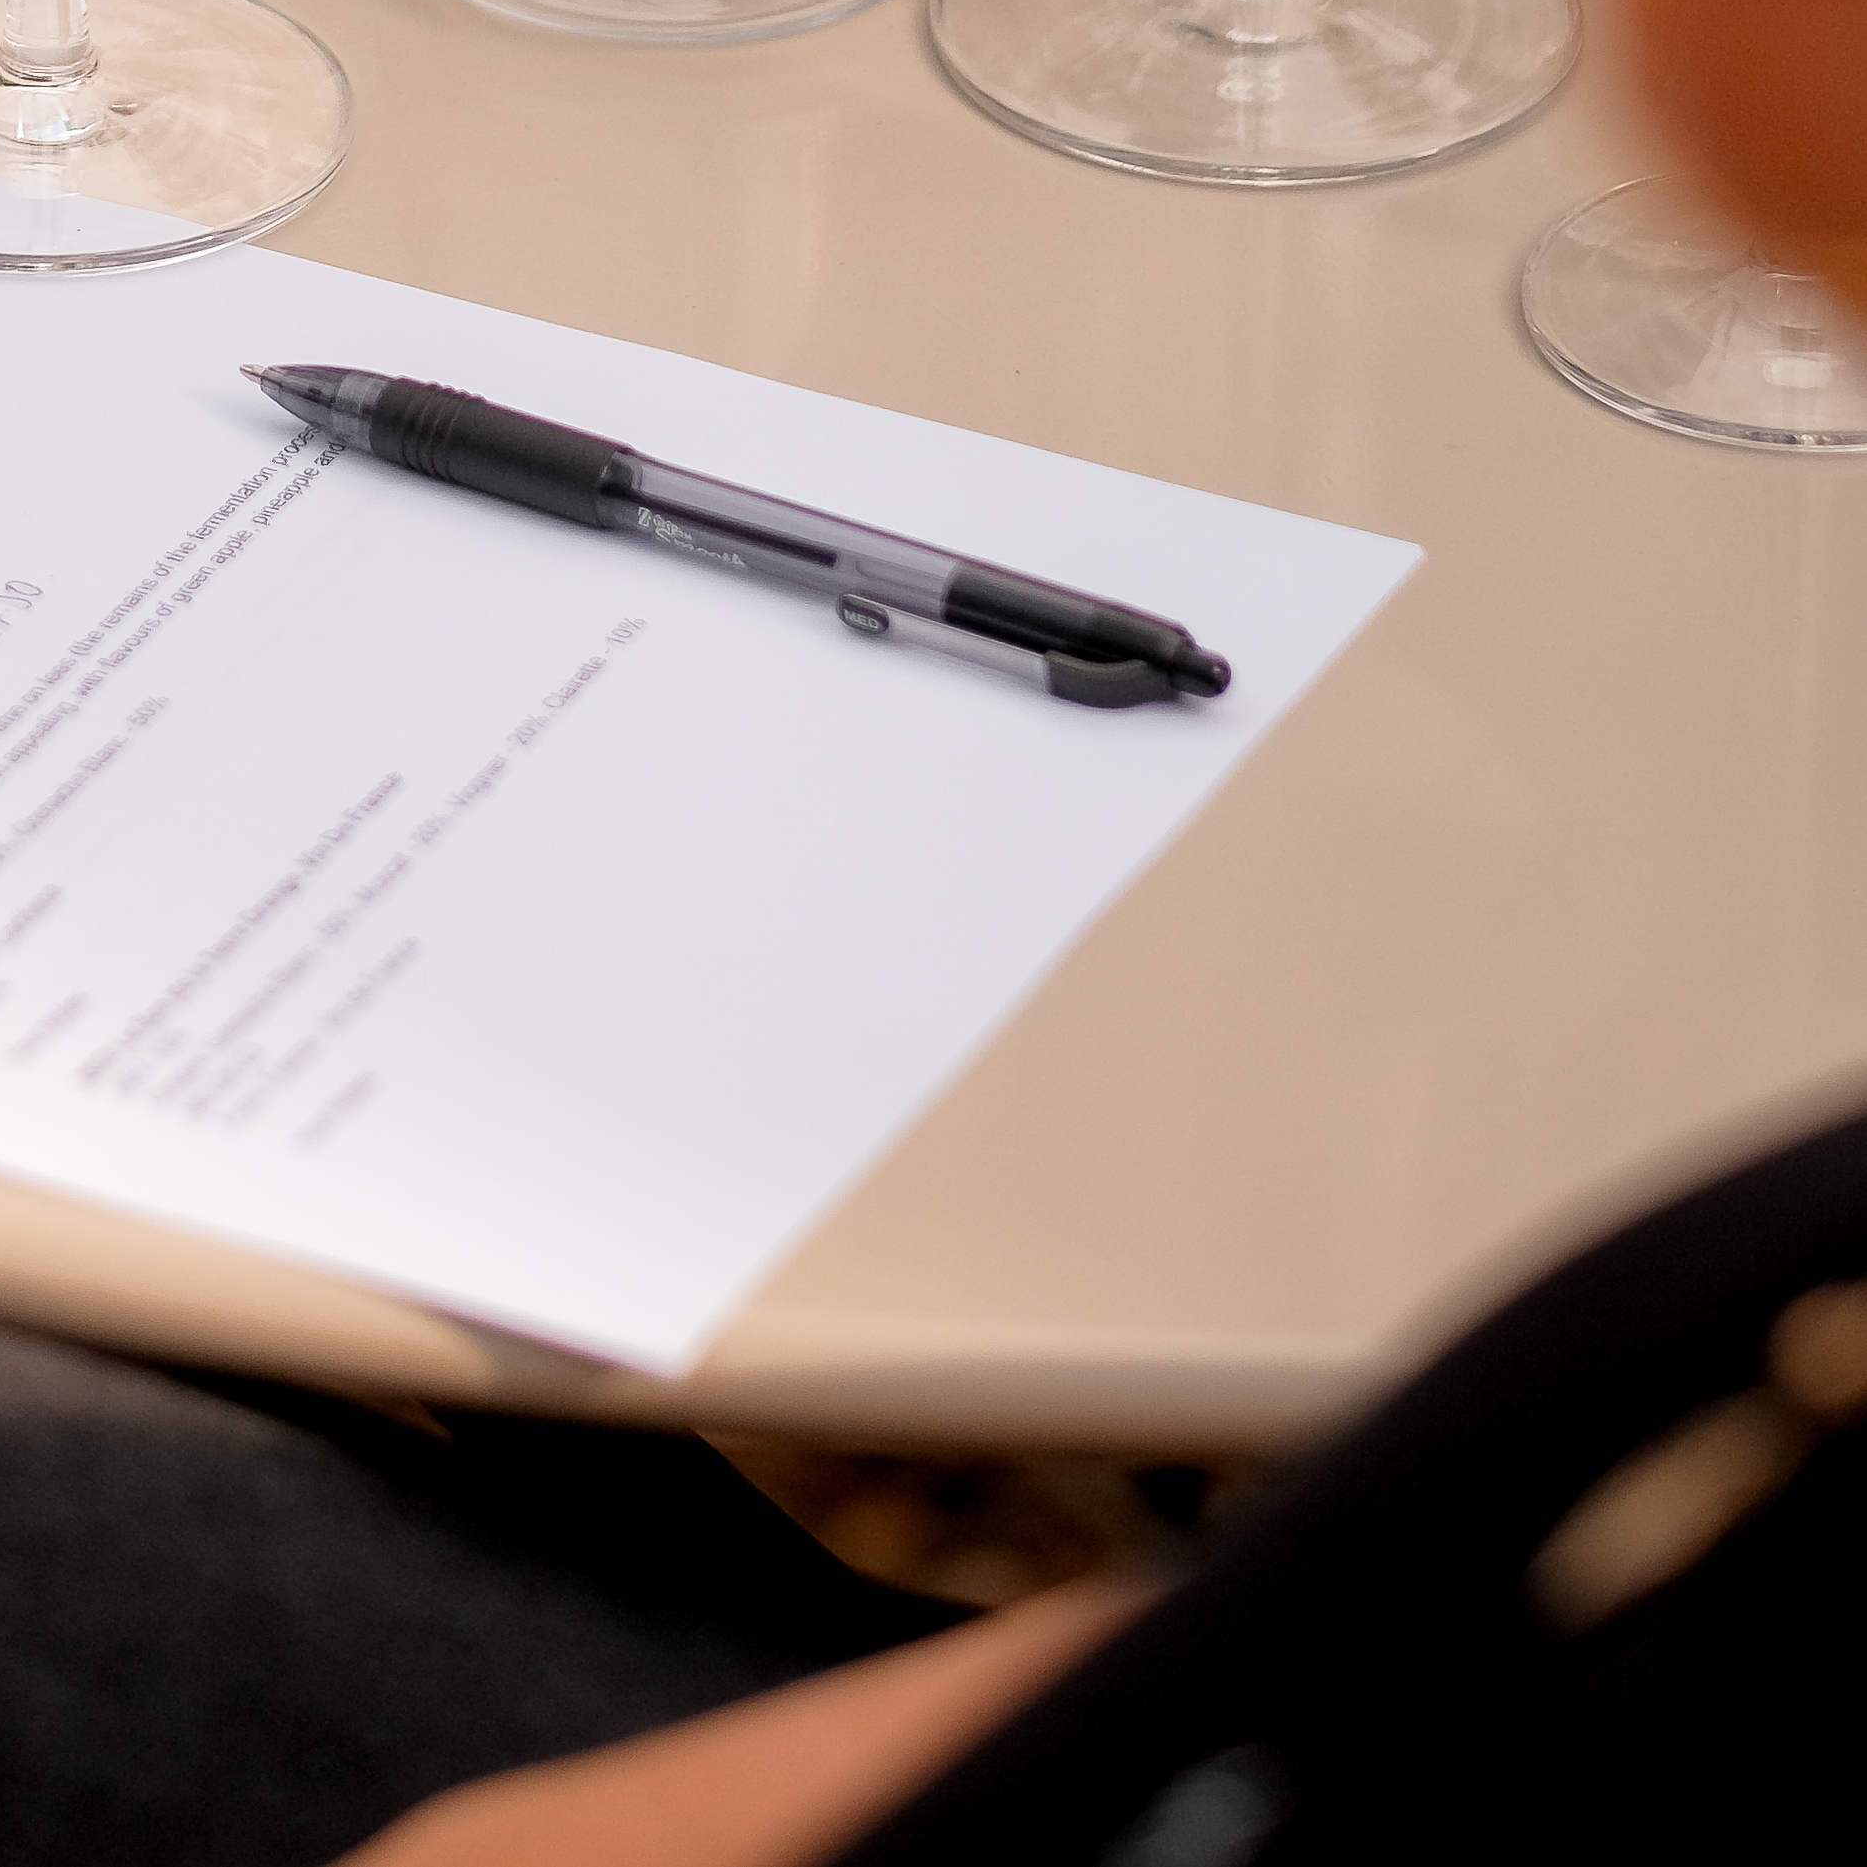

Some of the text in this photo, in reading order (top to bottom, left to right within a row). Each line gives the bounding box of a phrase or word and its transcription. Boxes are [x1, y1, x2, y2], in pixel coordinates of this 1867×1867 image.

[21, 685, 49, 705] on
[36, 657, 78, 687] lees
[69, 630, 105, 656] (the
[99, 578, 159, 629] remains
[152, 560, 174, 577] of
[165, 541, 198, 562] the
[186, 466, 278, 540] fermentation
[75, 669, 108, 697] with
[97, 618, 162, 668] flavours
[155, 601, 177, 617] of
[170, 565, 216, 603] green
[210, 529, 254, 564] apple,
[251, 467, 320, 526] pineapple
[313, 439, 355, 466] and
[606, 617, 646, 644] 10%
